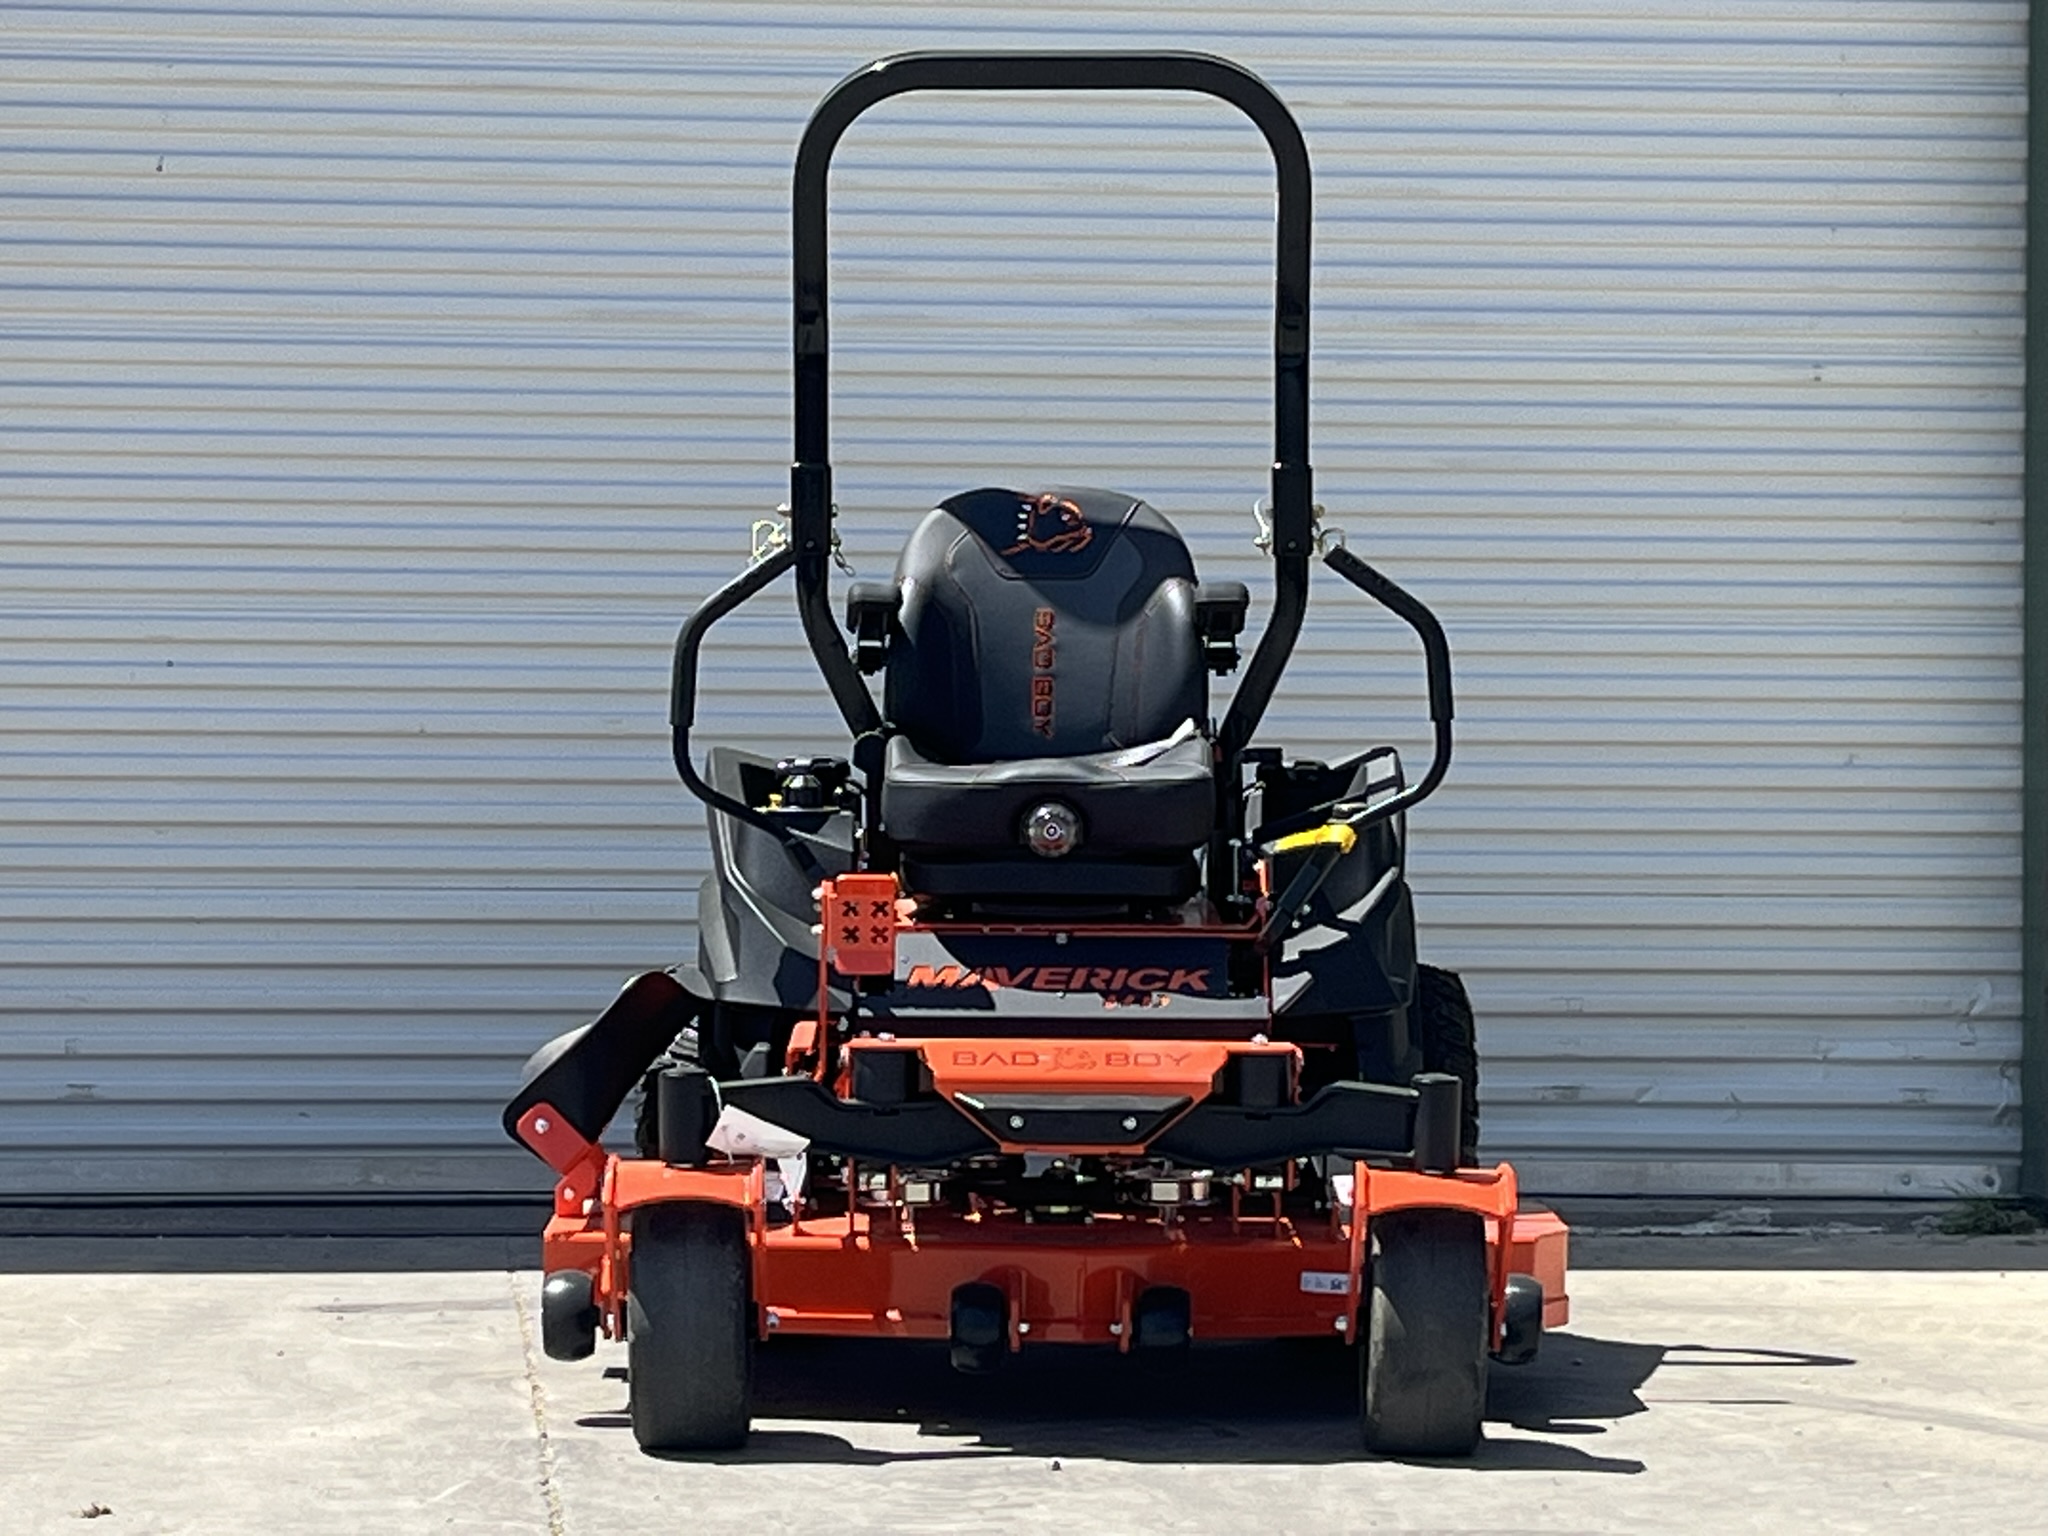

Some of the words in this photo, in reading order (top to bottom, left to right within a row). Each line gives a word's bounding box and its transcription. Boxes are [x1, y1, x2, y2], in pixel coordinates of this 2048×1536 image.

[1033, 607, 1055, 670] BAD
[1032, 676, 1055, 739] BOY
[907, 965, 1210, 991] MAVERICK
[953, 1051, 1039, 1066] BAD
[1105, 1052, 1192, 1067] BOY
